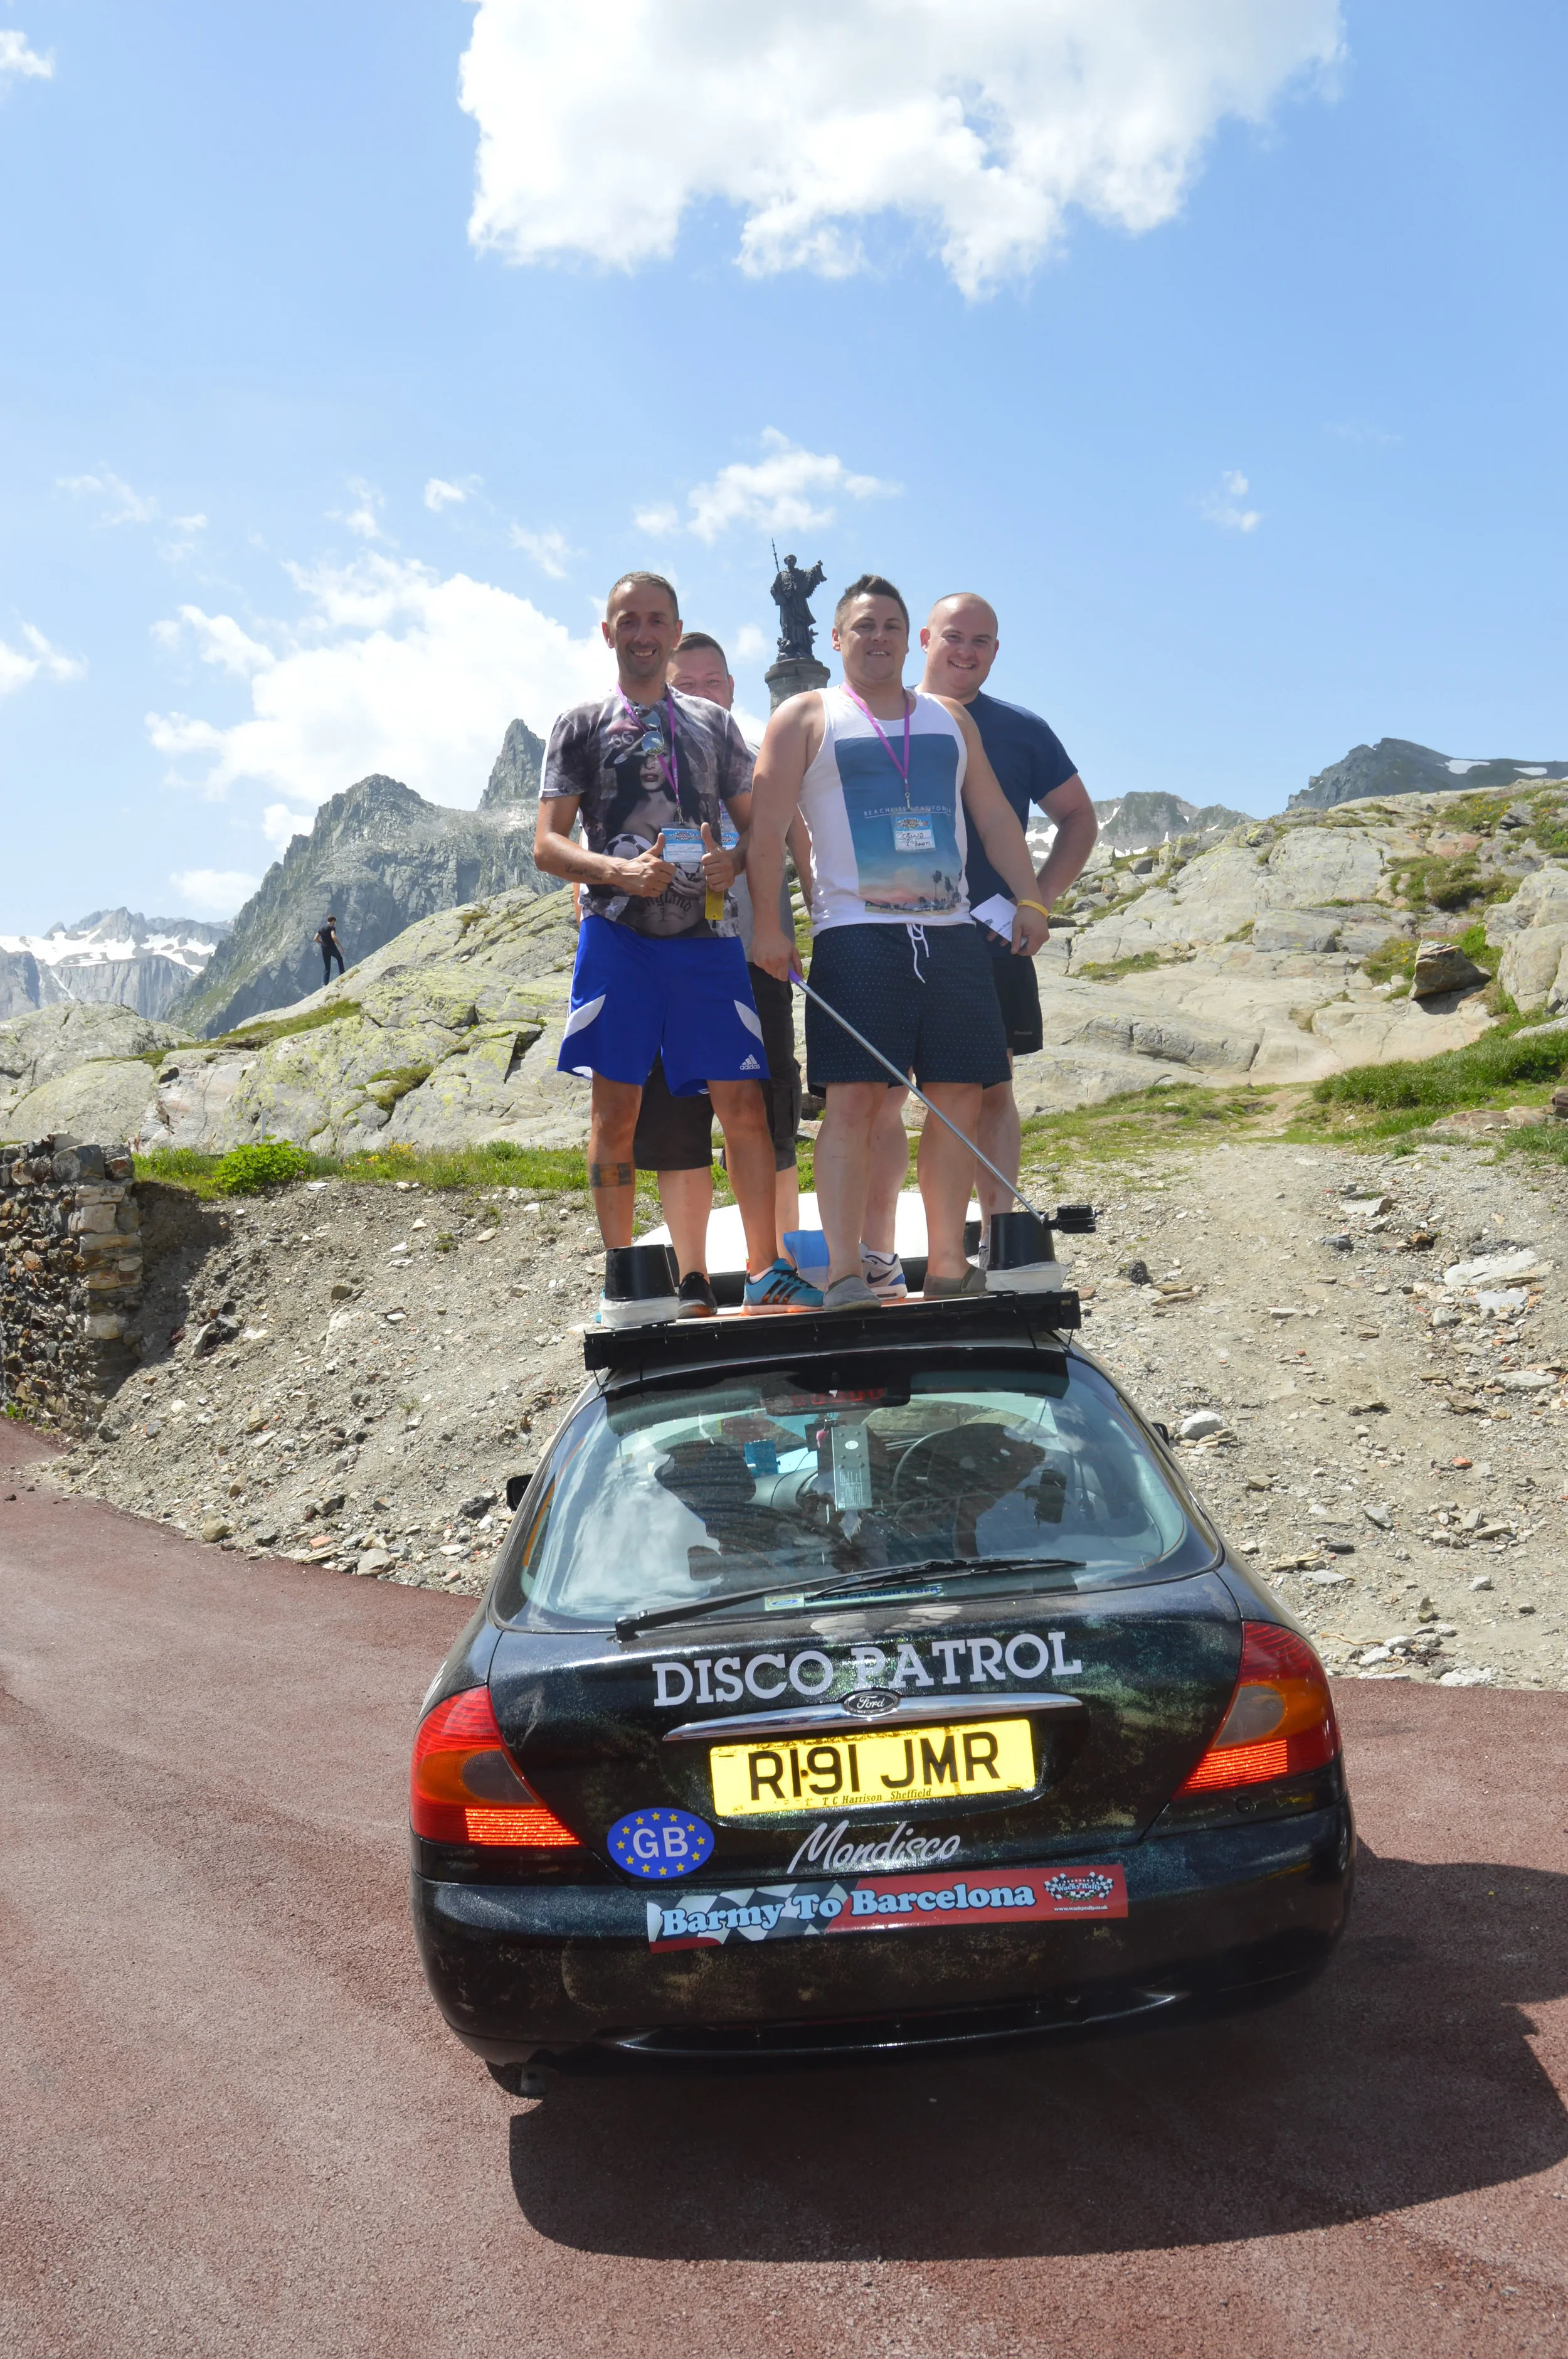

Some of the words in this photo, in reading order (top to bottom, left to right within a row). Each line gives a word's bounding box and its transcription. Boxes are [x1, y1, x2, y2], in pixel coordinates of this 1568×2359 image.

[652, 1650, 834, 1707] DISCO
[850, 1631, 1083, 1690] PATROL
[857, 1695, 885, 1709] Ford
[748, 1744, 861, 1801] R191
[881, 1731, 1000, 1789] JMR
[823, 1797, 829, 1806] T
[832, 1796, 838, 1804] C
[842, 1793, 882, 1804] Harrison
[891, 1788, 931, 1799] Sheffield
[632, 1826, 689, 1859] GB
[787, 1819, 961, 1874] Mondisco
[1056, 1883, 1080, 1892] Wacky
[1082, 1883, 1101, 1891] Rally
[660, 1900, 785, 1937] Barmy
[792, 1893, 844, 1921] To
[850, 1883, 1036, 1915] Barcelona
